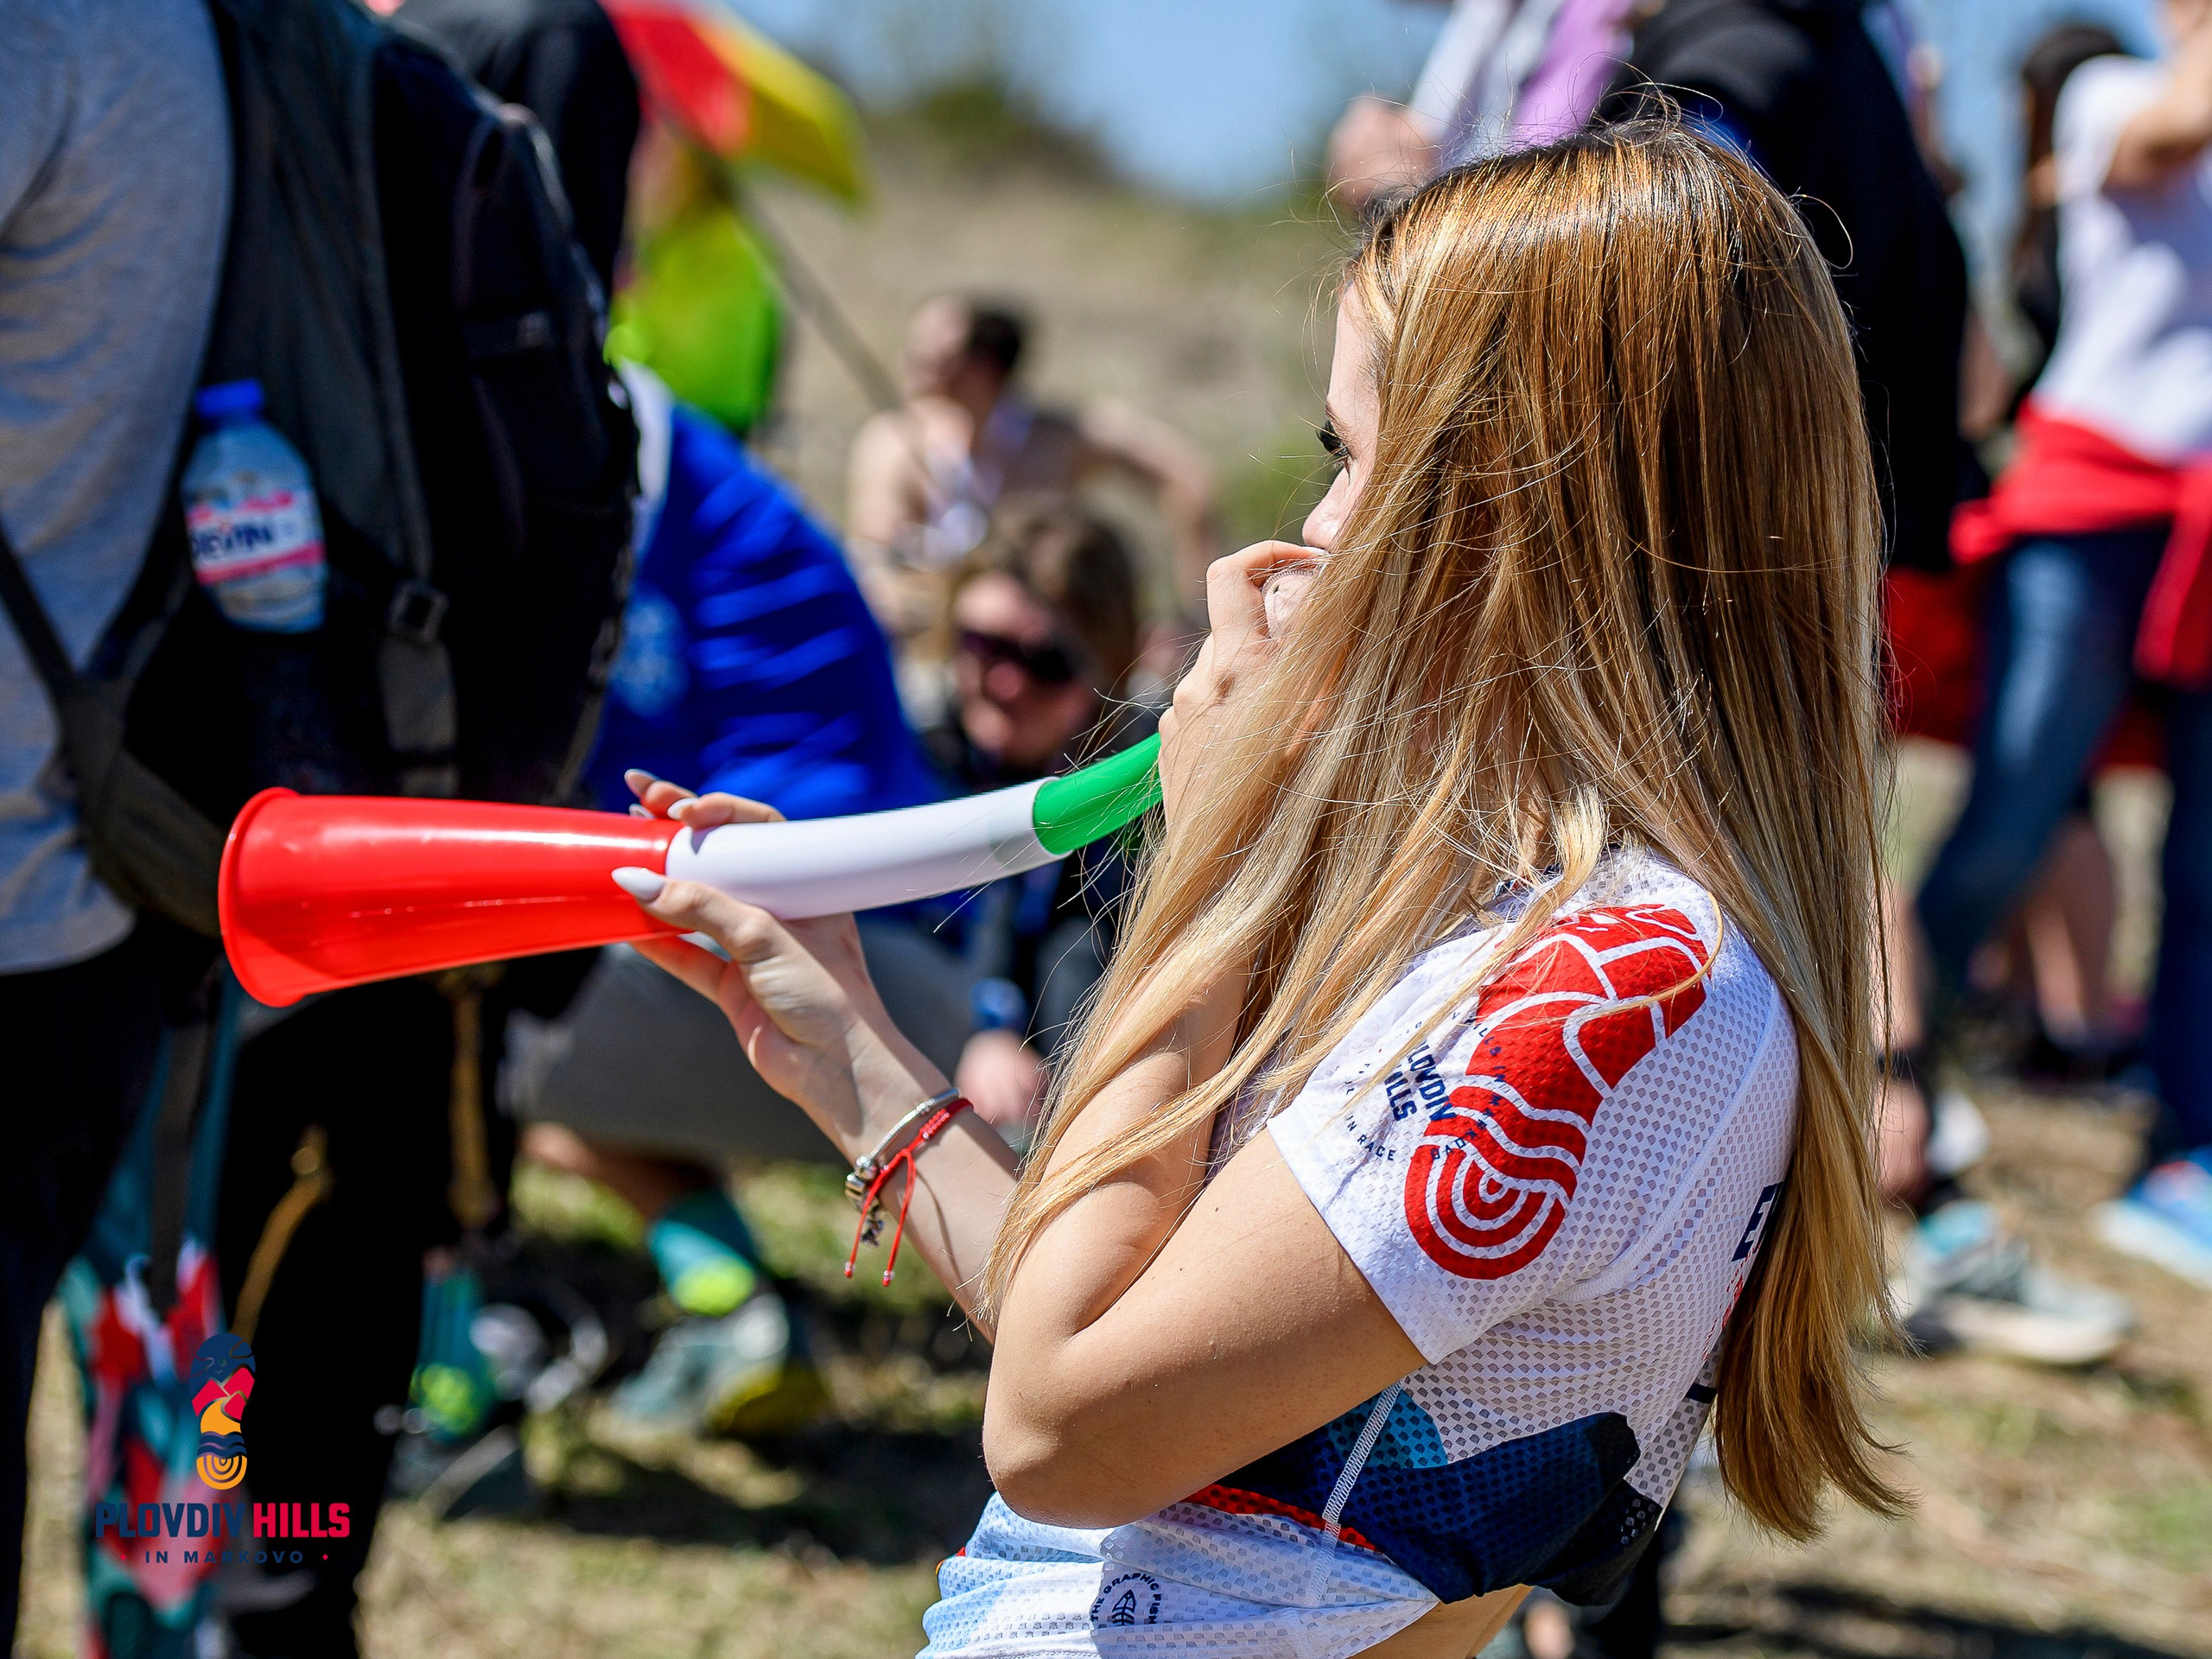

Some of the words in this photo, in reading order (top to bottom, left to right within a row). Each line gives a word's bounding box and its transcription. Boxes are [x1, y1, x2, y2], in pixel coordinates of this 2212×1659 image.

[1384, 1065, 1417, 1122] ILLS
[1407, 1041, 1457, 1122] LOVDIV
[1357, 1134, 1396, 1161] RACE
[1090, 1598, 1105, 1623] THE
[1103, 1573, 1160, 1594] GRAPHIC
[1148, 1593, 1162, 1624] FISH
